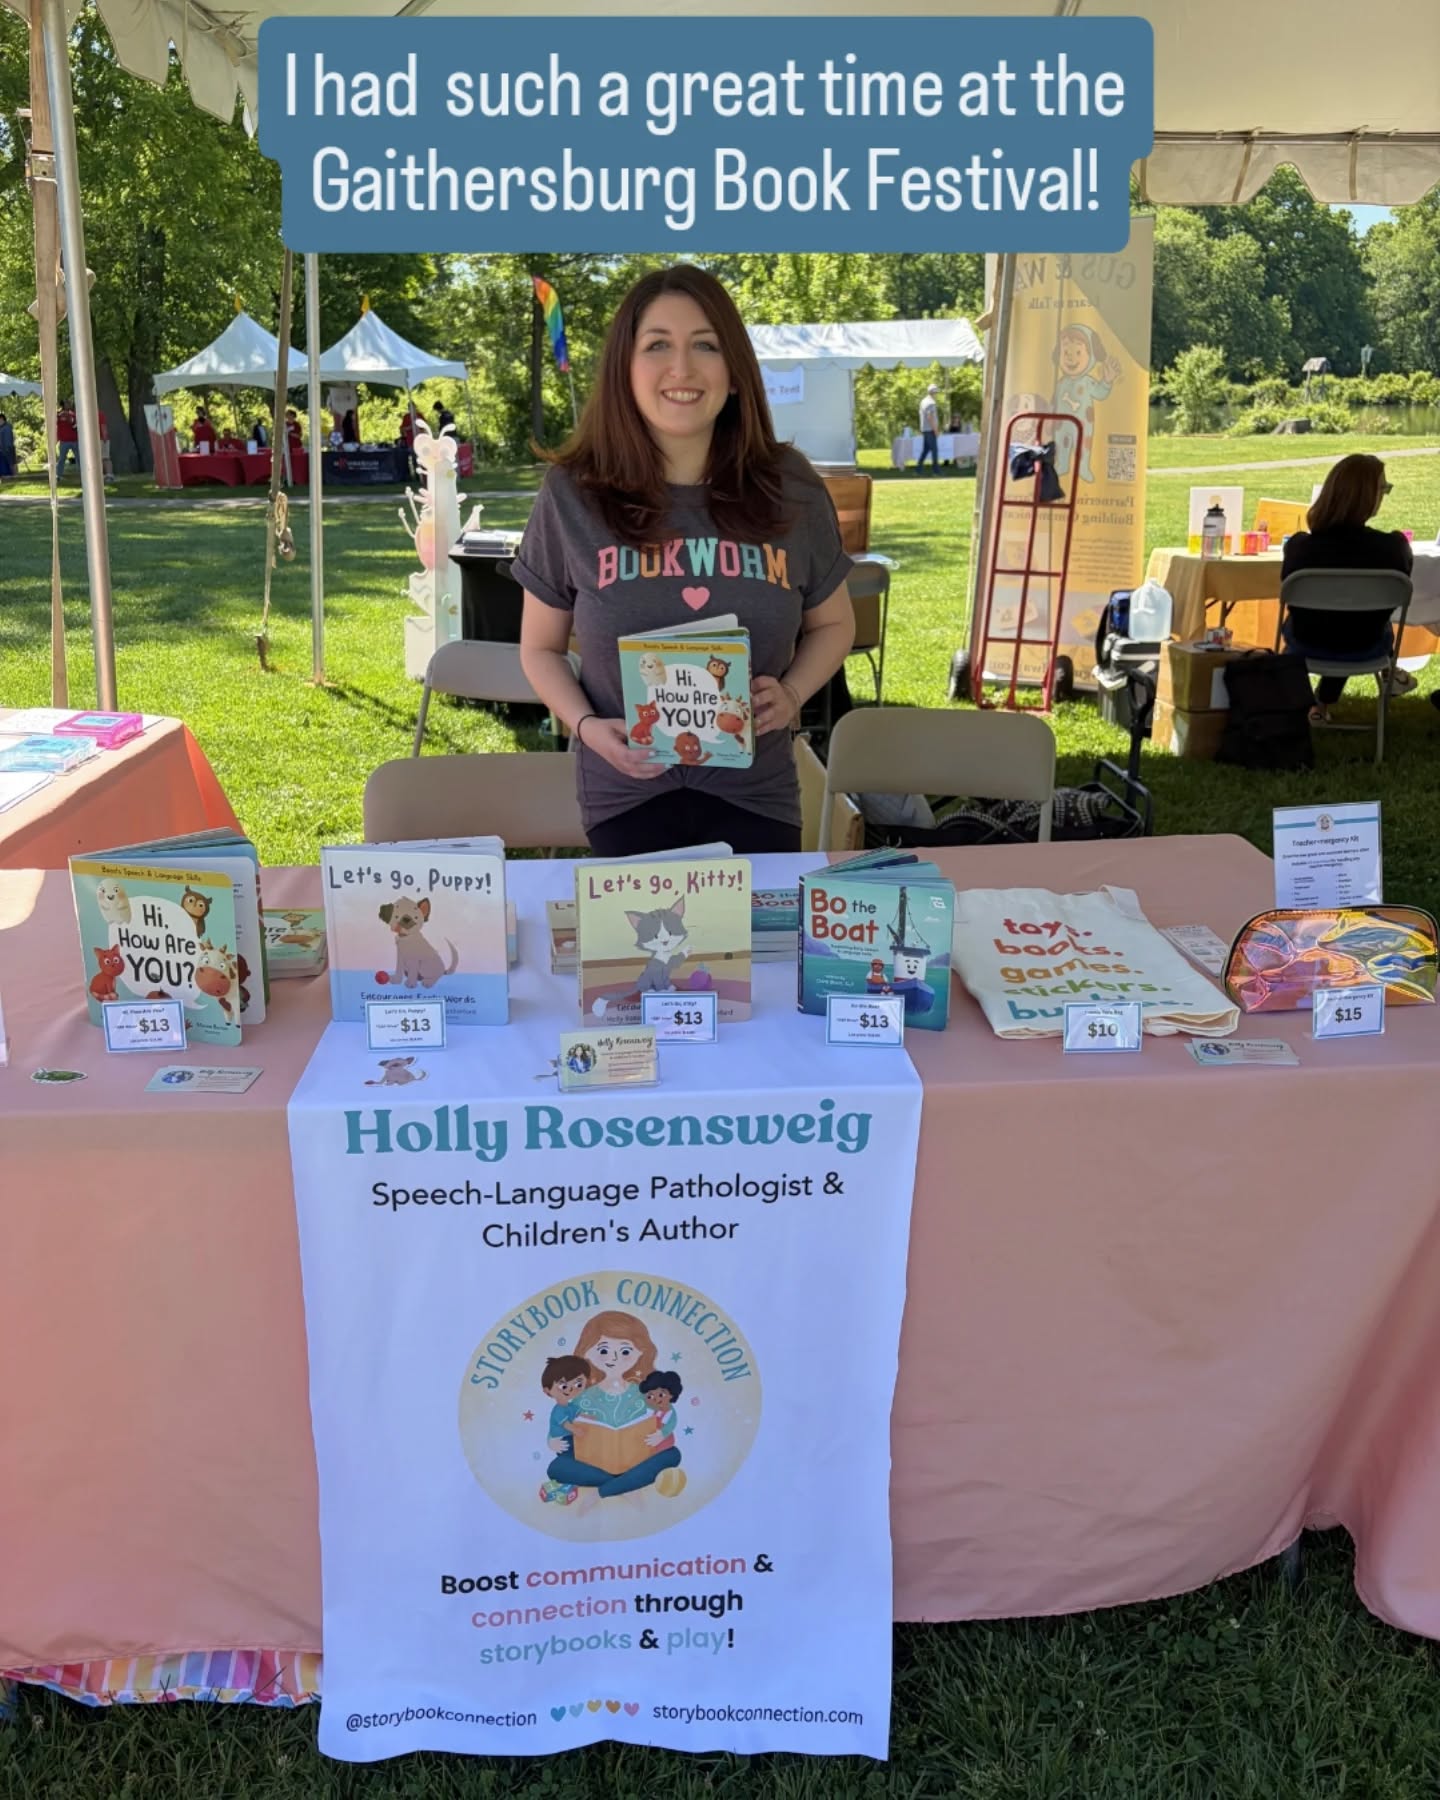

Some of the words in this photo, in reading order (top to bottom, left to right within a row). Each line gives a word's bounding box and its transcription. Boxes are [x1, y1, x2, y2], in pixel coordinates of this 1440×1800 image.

[597, 538, 792, 590] BOOKWORM
[655, 688, 689, 704] How
[693, 690, 718, 706] Are
[661, 707, 717, 728] YOU?
[329, 865, 382, 889] Let's
[390, 869, 421, 893] go,
[428, 868, 492, 894] Puppy!
[589, 874, 642, 899] Let's
[650, 874, 679, 896] go,
[686, 870, 743, 894] Kitty!
[810, 888, 847, 914] Bo
[852, 900, 877, 914] the
[142, 903, 169, 929] Hi,
[811, 914, 880, 944] Boat
[118, 927, 160, 950] How
[164, 934, 196, 956] Are
[993, 934, 1124, 956] books.
[126, 953, 195, 989] YOU?
[1000, 958, 1144, 984] games.
[139, 1018, 170, 1034] $13
[400, 1017, 431, 1034] $13
[674, 1010, 703, 1026] $13
[859, 1013, 889, 1029] $13
[1335, 1007, 1362, 1023] $15
[1087, 1022, 1119, 1038] $10
[344, 1104, 508, 1162] Holly
[524, 1098, 873, 1154] Rosensweig
[371, 1179, 640, 1212] Speech-Language
[651, 1173, 813, 1204] Pathologist
[822, 1171, 845, 1195] &
[482, 1218, 630, 1248] Children's
[639, 1215, 740, 1242] Author
[470, 1279, 601, 1390] STORYBOOK
[616, 1278, 752, 1383] CONNECTION
[441, 1571, 519, 1596] Boost
[526, 1554, 747, 1588] communication
[753, 1553, 775, 1574] &
[471, 1596, 628, 1629] connection
[634, 1589, 744, 1619] through
[480, 1629, 632, 1665] storybooks
[638, 1628, 660, 1651] &
[666, 1626, 735, 1656] play!
[346, 1705, 538, 1733] @storybookconnection
[652, 1702, 864, 1726] storybookconnection.com
